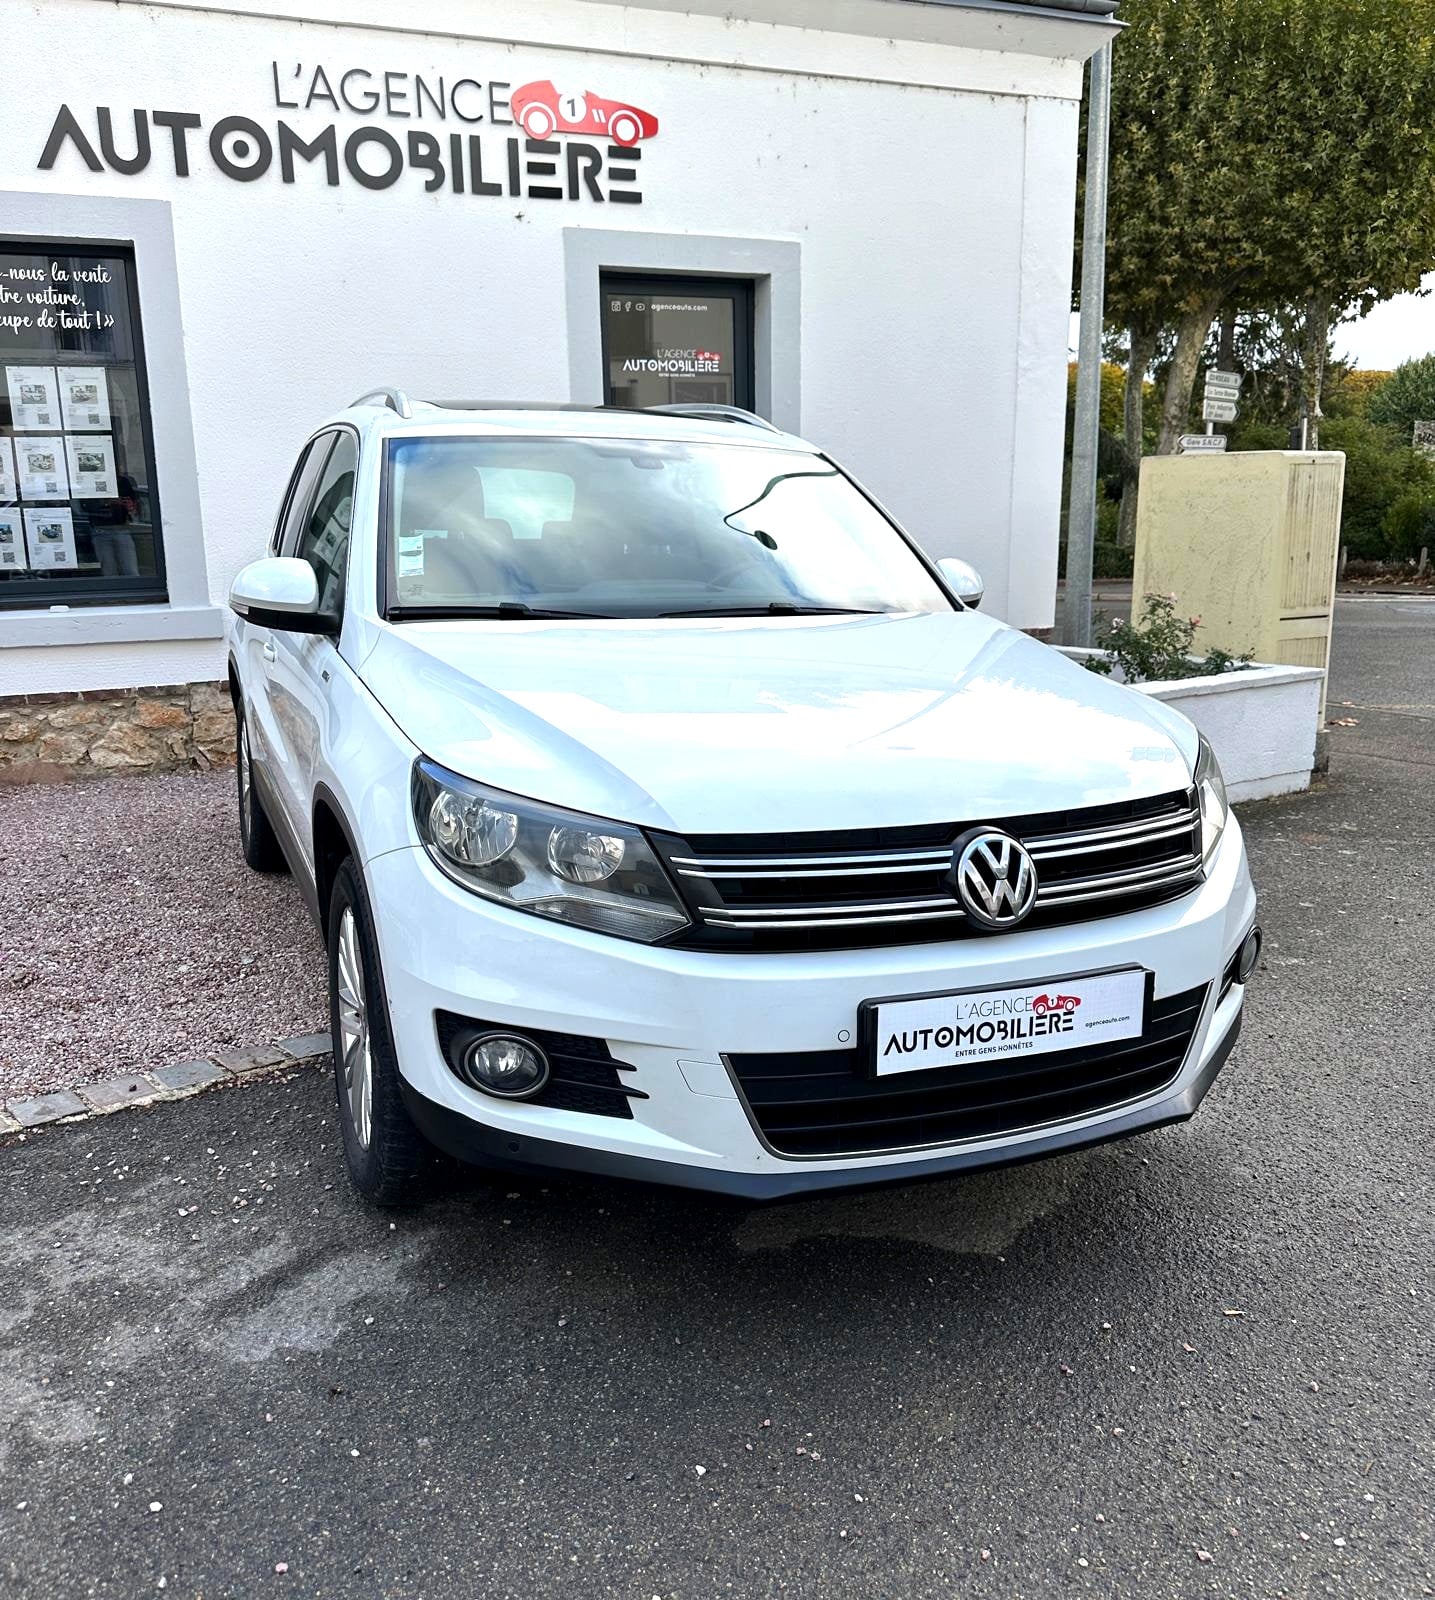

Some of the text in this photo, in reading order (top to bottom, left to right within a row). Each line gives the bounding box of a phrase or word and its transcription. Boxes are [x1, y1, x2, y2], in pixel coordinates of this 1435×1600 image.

[272, 60, 512, 126] L'AGENCE
[566, 97, 577, 118] 1
[51, 261, 70, 282] la
[73, 264, 112, 284] vente
[26, 285, 86, 307] voiture,
[37, 308, 58, 329] de
[56, 310, 94, 330] tout
[656, 348, 697, 360] L'AGENCE
[955, 995, 1034, 1021] L'AGENCE
[1084, 1015, 1130, 1028] agenceauto.com
[955, 1041, 1034, 1058] ENTRE GENS HONNÊTES
